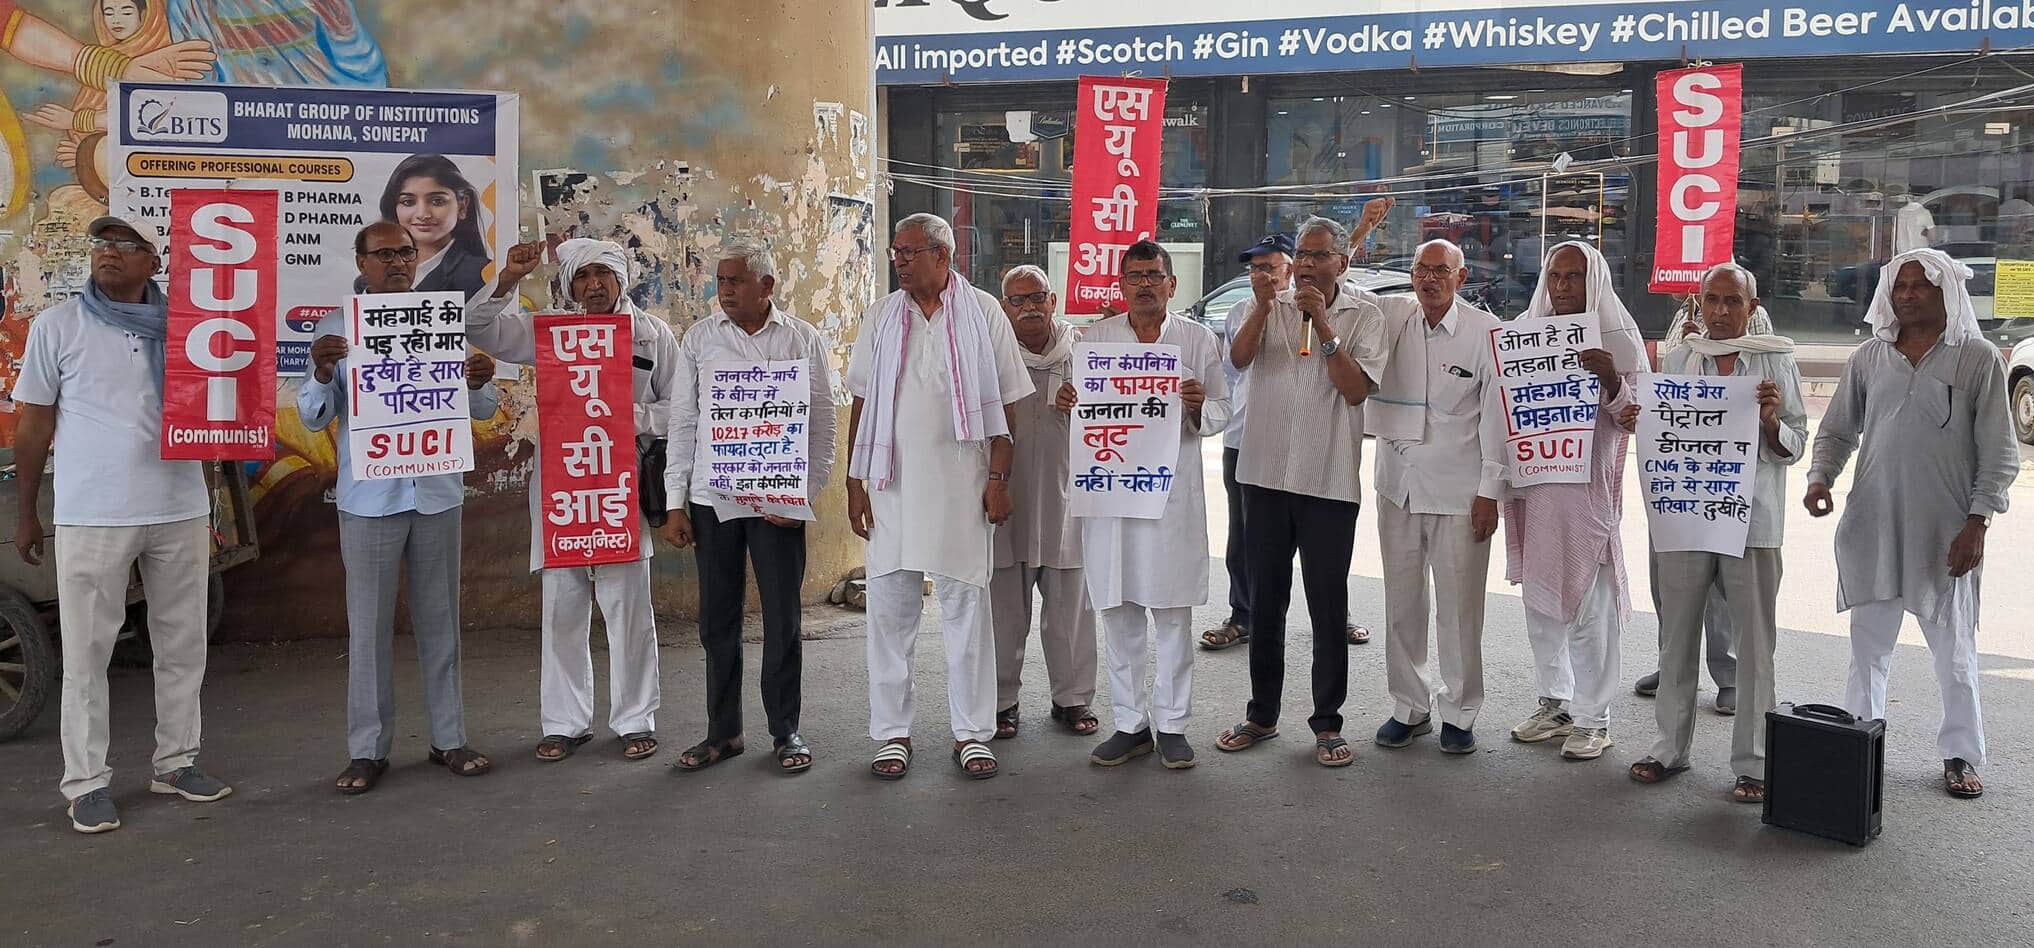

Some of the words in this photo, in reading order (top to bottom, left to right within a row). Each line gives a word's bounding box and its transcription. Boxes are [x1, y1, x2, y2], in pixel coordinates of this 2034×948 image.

[876, 43, 906, 69] All
[914, 40, 1047, 75] imported
[1056, 35, 1183, 65] #Scotch
[1192, 31, 1268, 59] #Gin
[1279, 26, 1412, 56] #Vodka
[1423, 17, 1600, 51] #Whiskey
[1610, 9, 1770, 42] #Chilled
[1783, 6, 1876, 37] Beer
[1886, 1, 2034, 35] Availab
[234, 100, 294, 119] BHARAT
[299, 103, 352, 121] GROUP
[355, 105, 374, 121] OF
[379, 105, 480, 125] INSTITUTIONS
[1092, 84, 1154, 122] एस
[287, 123, 357, 142] MOHANA,
[362, 125, 428, 143] SONEPAT
[1103, 125, 1141, 178] यू
[139, 159, 196, 173] OFFERING
[201, 161, 285, 175] PROFESSIONAL
[290, 163, 341, 176] COURSES
[1670, 71, 1724, 264] SUCI
[285, 192, 294, 203] B
[297, 192, 363, 205] PHARMA
[1091, 183, 1139, 232] सी
[285, 212, 295, 224] D
[298, 212, 364, 226] PHARMA
[285, 233, 322, 246] ANM
[285, 253, 322, 266] GNM
[185, 202, 258, 421] SUCI
[439, 300, 463, 325] की
[400, 328, 434, 354] रही
[434, 332, 467, 351] मार
[549, 324, 617, 362] एस
[1498, 329, 1542, 352] जीना
[1545, 324, 1562, 348] है
[1566, 323, 1588, 346] तो
[359, 357, 406, 392] दुखी
[407, 354, 427, 381] है
[1087, 351, 1117, 372] तेल
[1503, 355, 1560, 379] लड़ना
[567, 364, 613, 418] यू
[711, 385, 727, 401] के
[729, 385, 762, 402] बीच
[763, 385, 781, 401] में
[1083, 377, 1108, 393] का
[1109, 375, 1180, 396] फायदा
[1652, 378, 1692, 402] रसोई
[378, 383, 459, 414] परिवार
[710, 402, 739, 421] तेल
[796, 400, 809, 416] ने
[1077, 402, 1139, 421] जनता
[1140, 396, 1169, 419] की
[1651, 401, 1729, 430] पैट्रोल
[168, 425, 269, 448] (communist)
[711, 426, 749, 441] 10217
[751, 420, 785, 438] करोड़
[786, 422, 805, 435] का
[366, 428, 454, 459] SUCI
[561, 424, 614, 478] सी
[748, 440, 782, 460] लूटा
[1082, 425, 1145, 463] लूट
[1516, 438, 1583, 462] SUCI
[1655, 431, 1729, 456] डीजल
[1733, 441, 1752, 457] व
[366, 457, 465, 478] (COMMUNIST)
[711, 462, 747, 474] सरकार
[747, 459, 763, 473] को
[763, 462, 793, 473] जनता
[793, 457, 808, 472] की
[1645, 459, 1680, 474] CNG
[1683, 456, 1703, 474] के
[736, 477, 758, 491] इन
[1118, 466, 1174, 493] चलेगी
[1650, 476, 1677, 495] होने
[1681, 475, 1703, 496] से
[1703, 479, 1741, 497] सारा
[548, 471, 631, 528] आई
[1649, 496, 1701, 516] परिवार
[551, 527, 632, 557] (कम्युनिस्ट)
